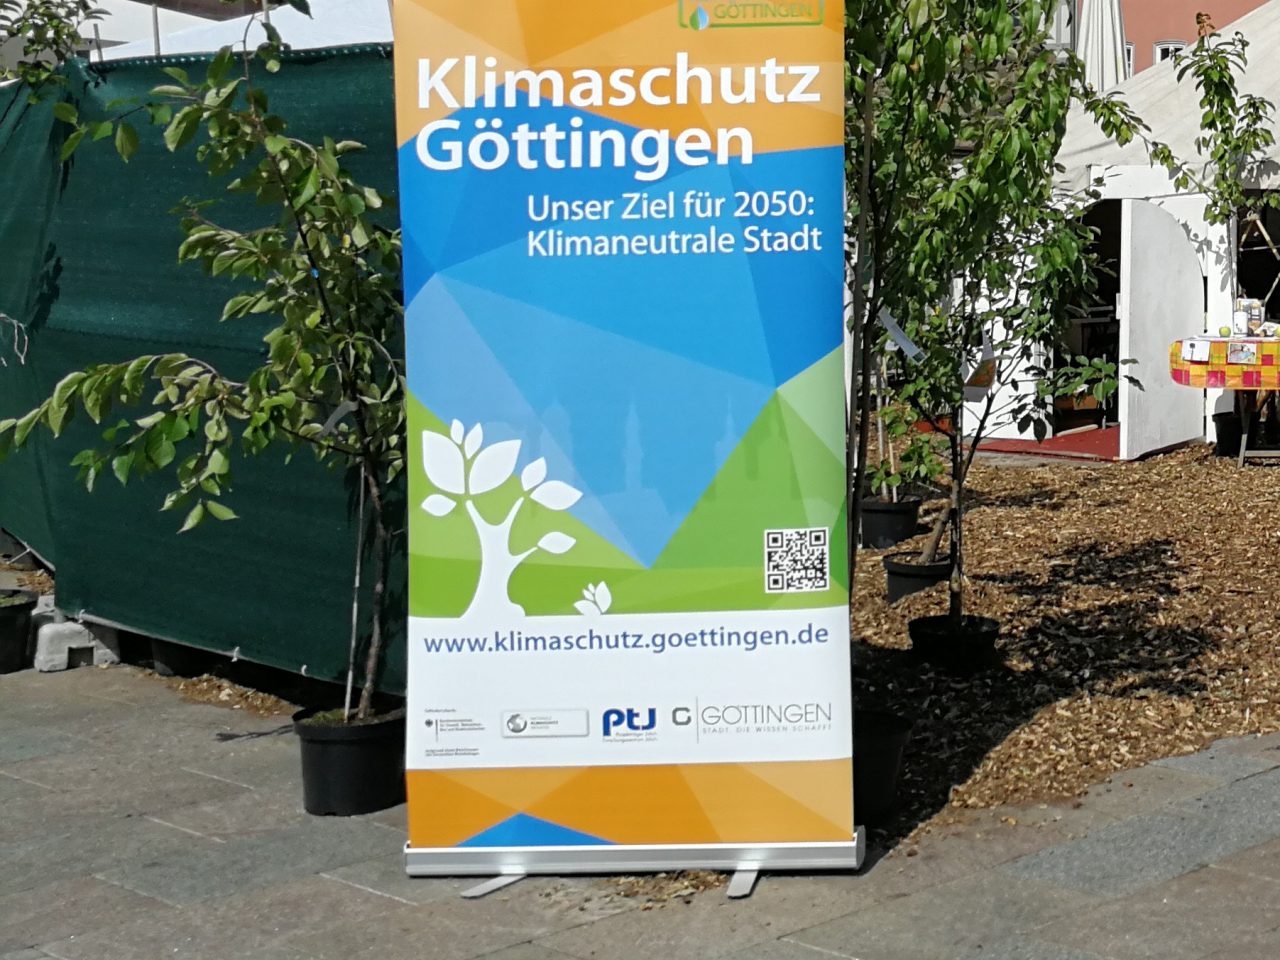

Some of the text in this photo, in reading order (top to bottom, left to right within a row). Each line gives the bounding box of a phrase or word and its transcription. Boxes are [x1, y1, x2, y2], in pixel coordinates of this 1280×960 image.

[713, 2, 814, 19] GÖTTINGEN
[417, 52, 822, 109] Klimaschutz
[415, 118, 754, 181] Göttingen
[527, 191, 815, 221] Unser Ziel für 2050:
[527, 224, 822, 257] Klimaneutrale Stadt
[423, 622, 830, 654] www.klimaschutz.goettingen.de
[701, 702, 833, 726] GÖTTINGEN
